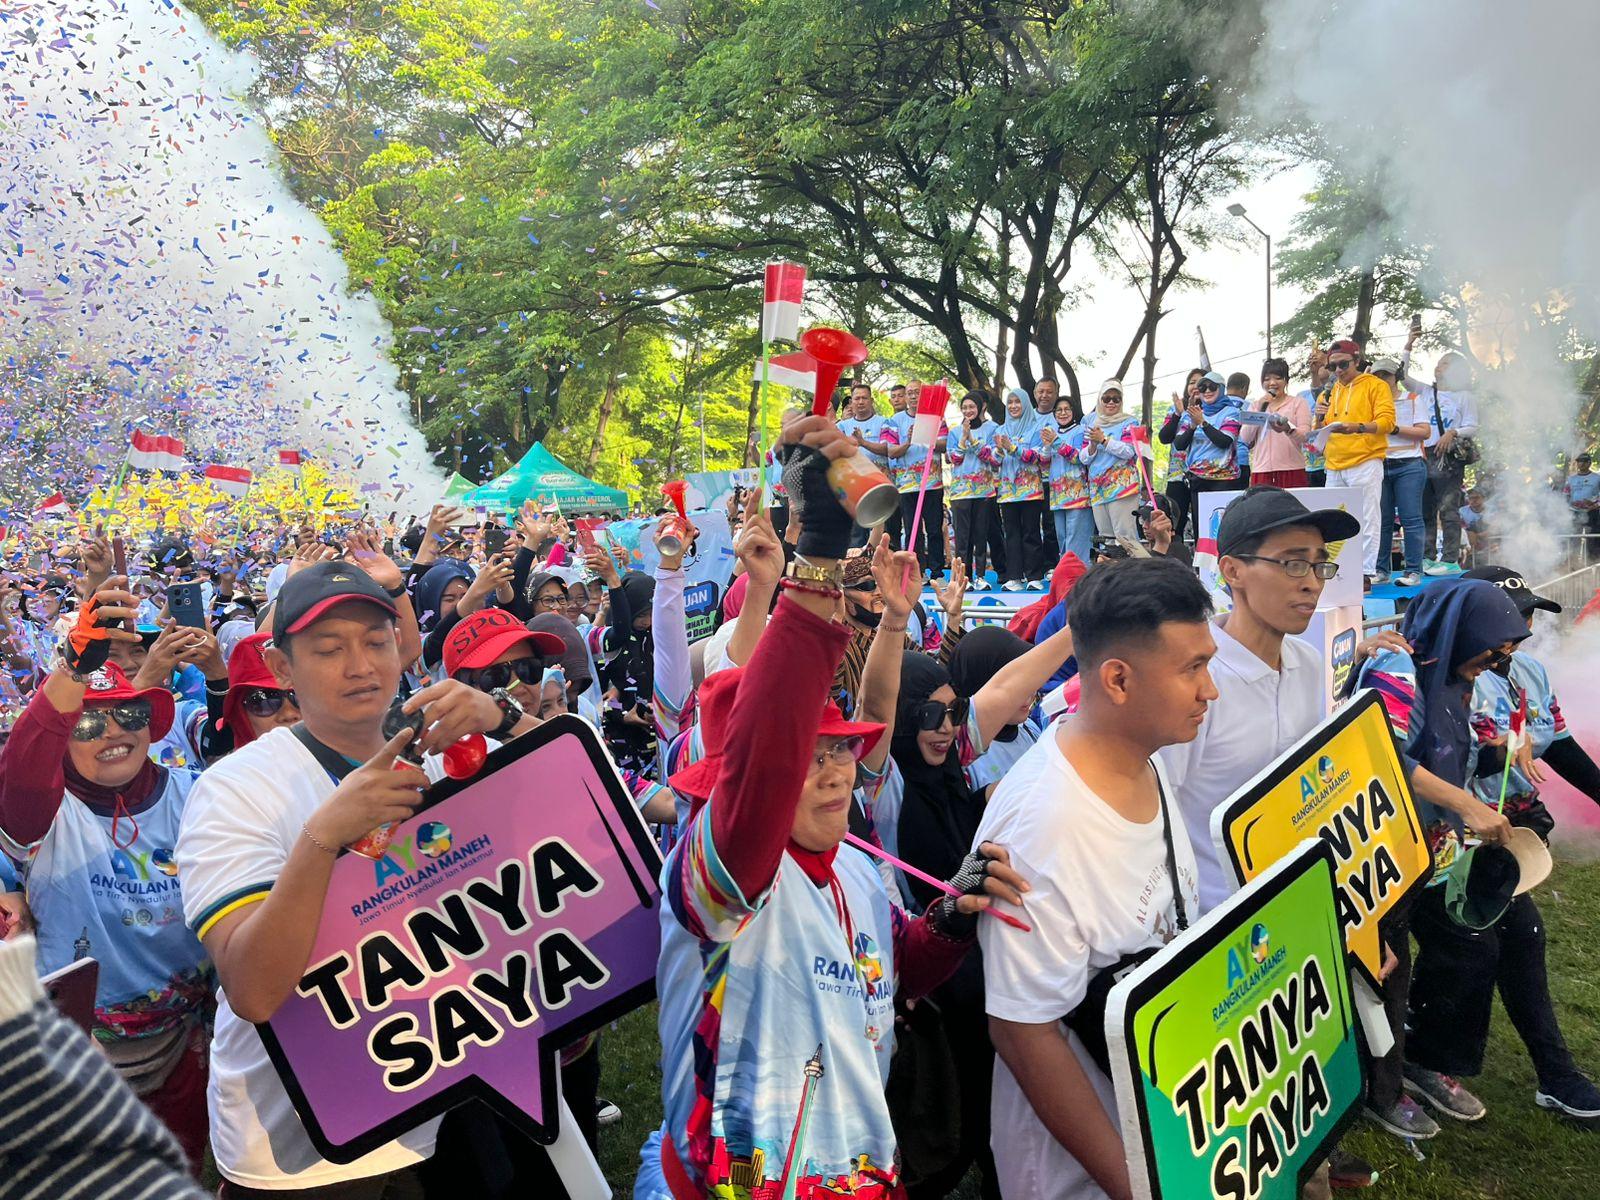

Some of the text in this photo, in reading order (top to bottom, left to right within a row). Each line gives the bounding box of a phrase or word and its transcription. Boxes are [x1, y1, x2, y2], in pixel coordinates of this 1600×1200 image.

[684, 589, 708, 607] UAN
[1291, 787, 1329, 825] RANGKULAN
[1328, 768, 1351, 793] MANEH
[1318, 777, 1396, 861] NYA
[351, 834, 492, 917] RANGKULAN MANEH
[359, 911, 381, 926] Jawa
[381, 897, 406, 914] Timur
[460, 848, 495, 871] Makmur
[1336, 844, 1402, 926] AYA
[297, 838, 602, 1027] TANYA
[369, 930, 608, 1090] SAYA
[1174, 957, 1330, 1153] TANYA
[1212, 1052, 1329, 1200] SAYA
